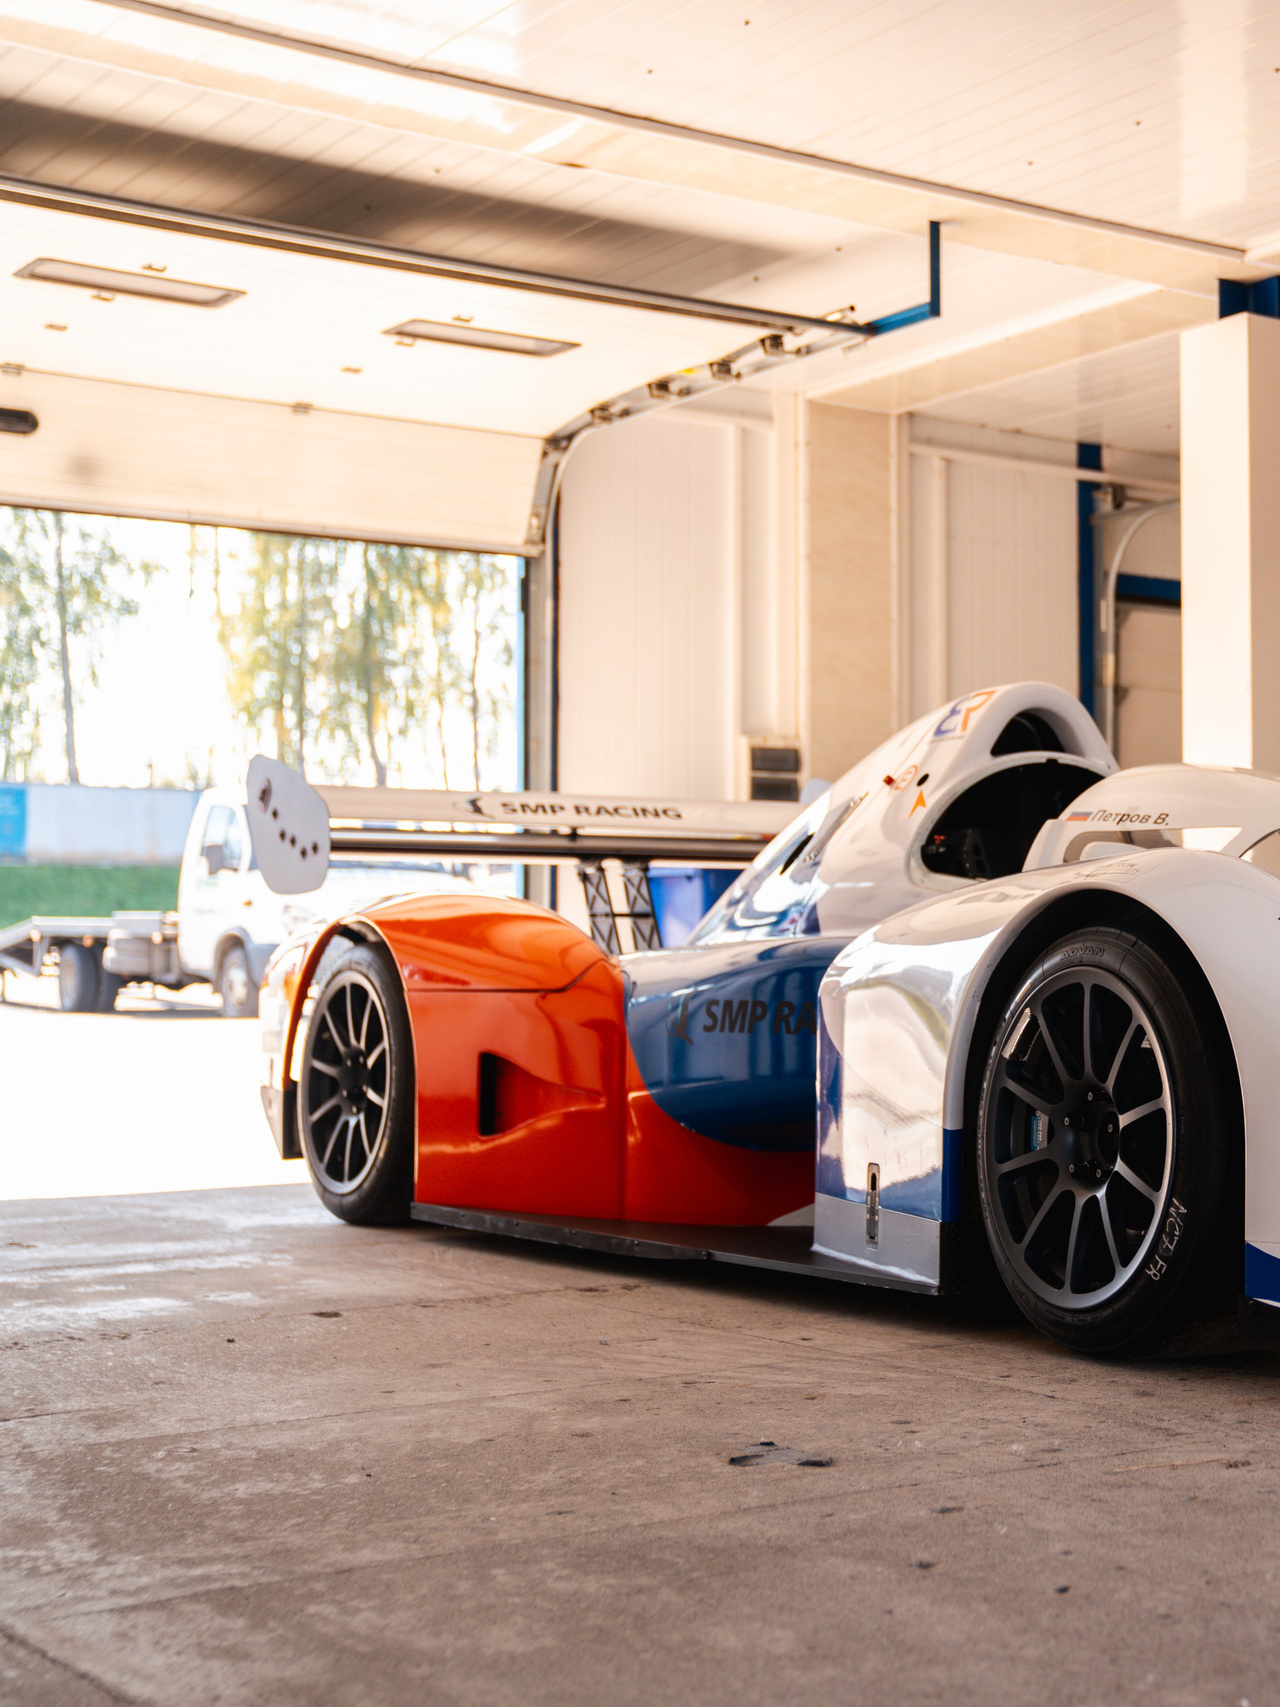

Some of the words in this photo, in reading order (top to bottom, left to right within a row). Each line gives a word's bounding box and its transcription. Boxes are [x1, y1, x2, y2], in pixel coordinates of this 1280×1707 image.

[502, 801, 565, 815] SMP
[573, 804, 683, 819] RACING
[1091, 810, 1151, 825] Петров
[1060, 946, 1105, 960] ADVAN
[702, 999, 767, 1033] SMP
